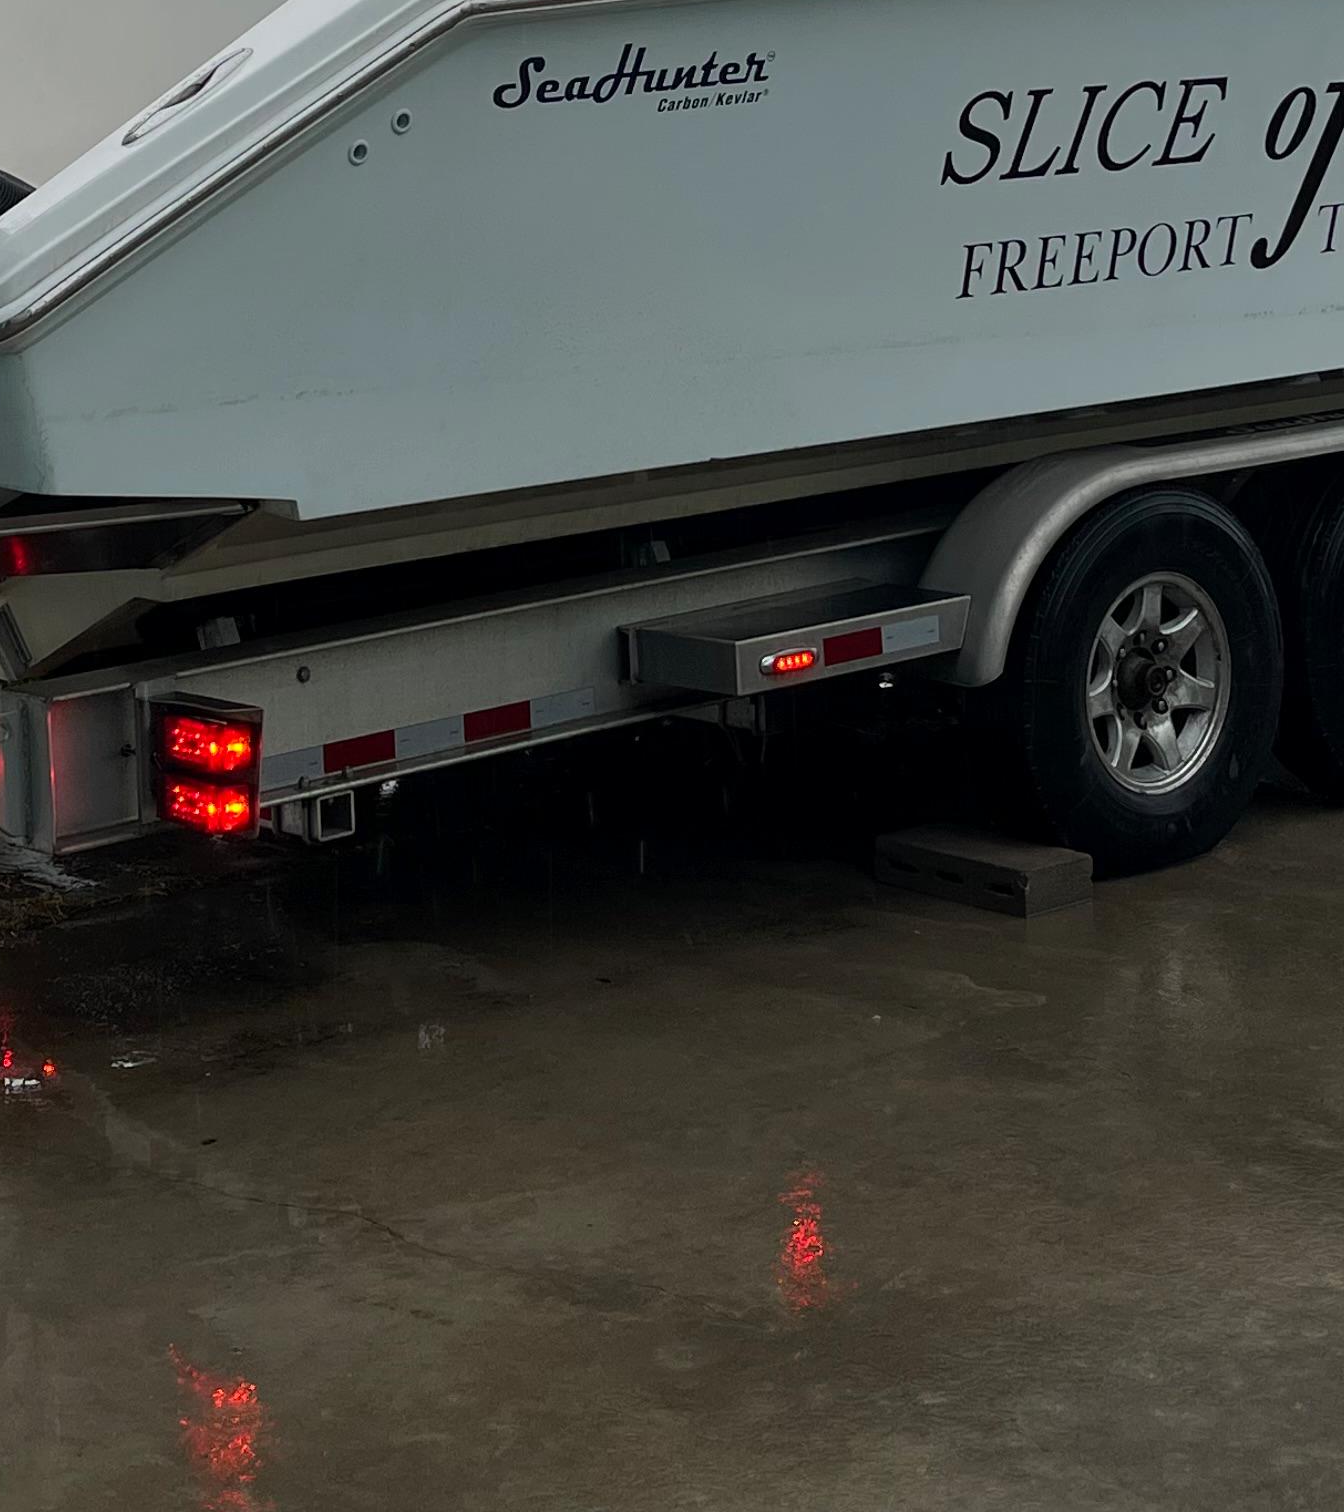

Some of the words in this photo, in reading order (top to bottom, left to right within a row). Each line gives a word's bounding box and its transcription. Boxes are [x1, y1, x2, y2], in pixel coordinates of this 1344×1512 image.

[492, 43, 768, 109] SeaHunter
[940, 76, 1229, 186] SLICE
[955, 213, 1254, 300] FREEPORT
